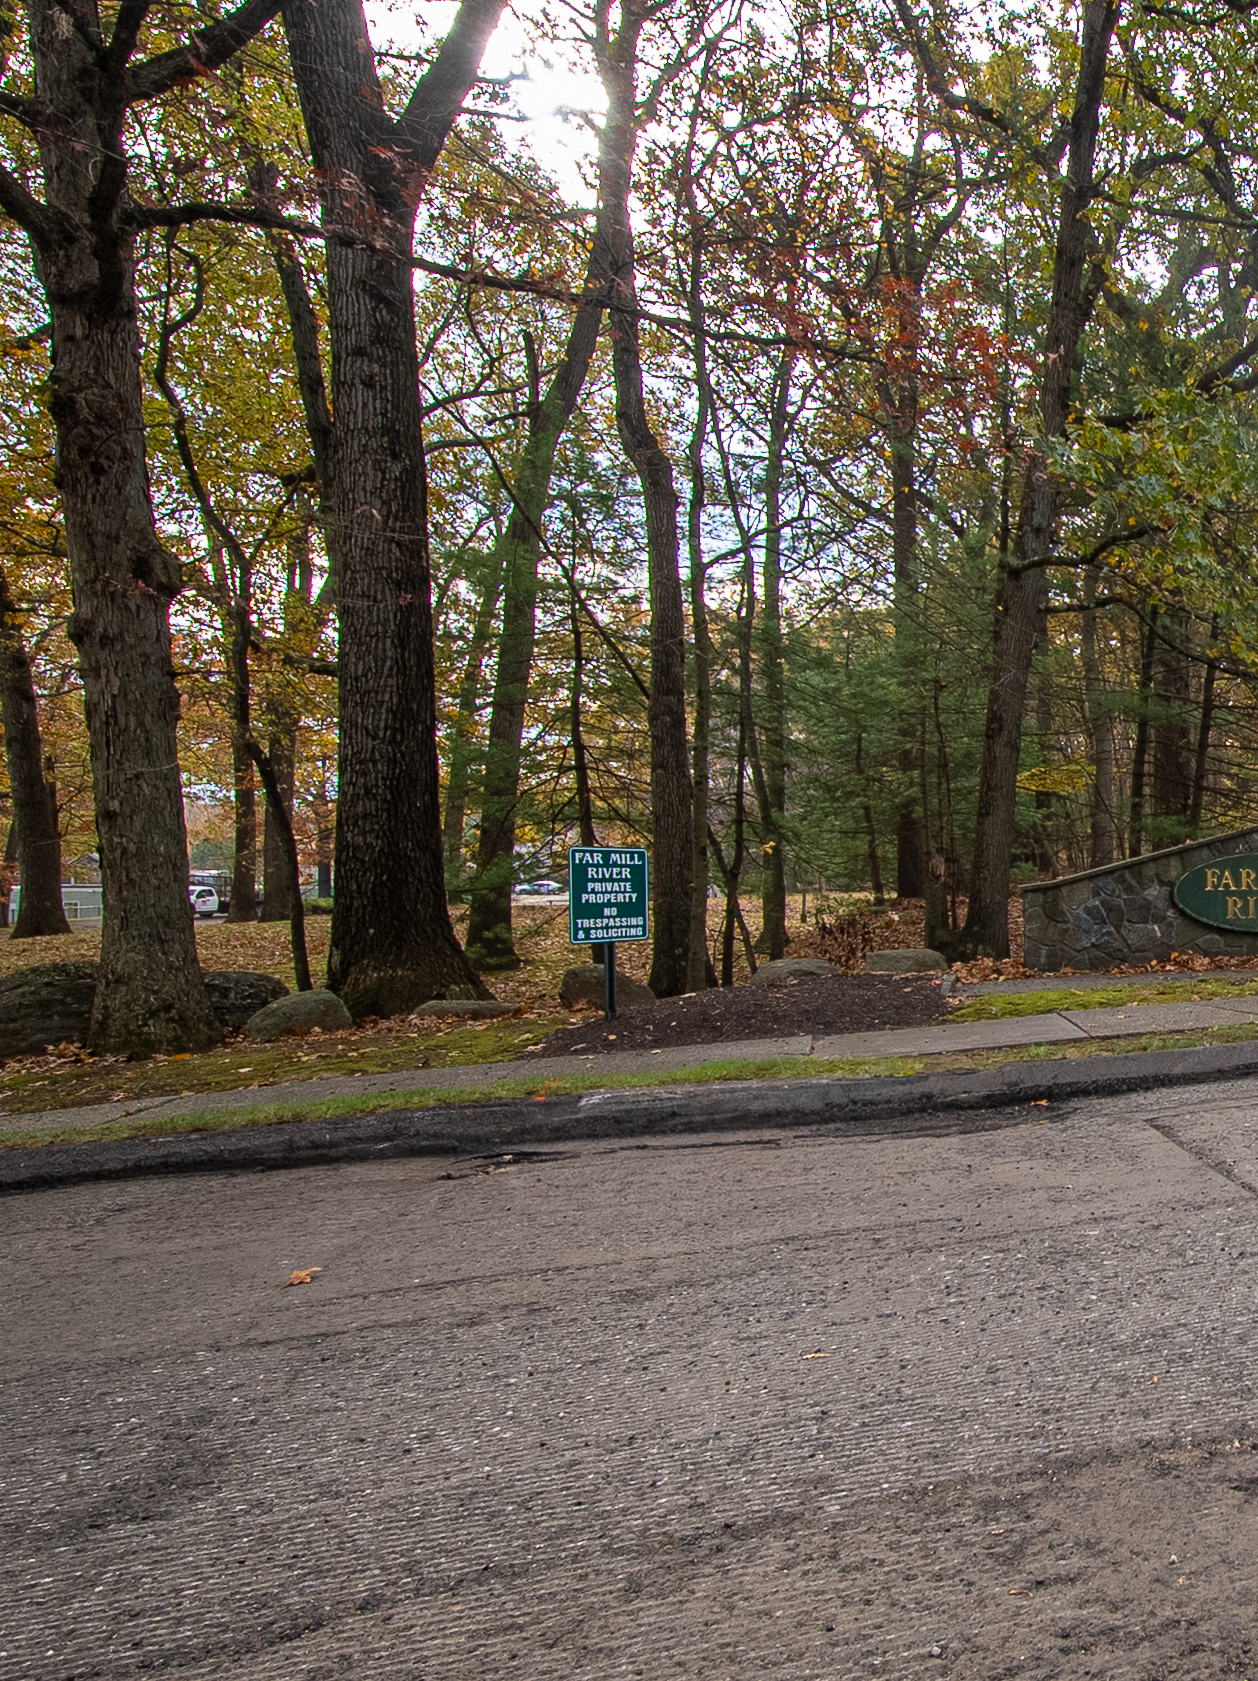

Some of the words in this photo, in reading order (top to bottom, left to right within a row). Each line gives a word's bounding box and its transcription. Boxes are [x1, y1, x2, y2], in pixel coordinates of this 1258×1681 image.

[574, 852, 603, 864] FAR
[609, 853, 642, 865] MILL
[587, 867, 631, 879] RIVER
[1204, 868, 1258, 891] FAR
[587, 882, 632, 892] PRIVATE
[581, 893, 637, 903] PROPERTY
[603, 907, 618, 916] NO
[576, 917, 644, 928] TRESPASSING
[577, 930, 585, 939] &
[589, 927, 643, 939] SOLICITING
